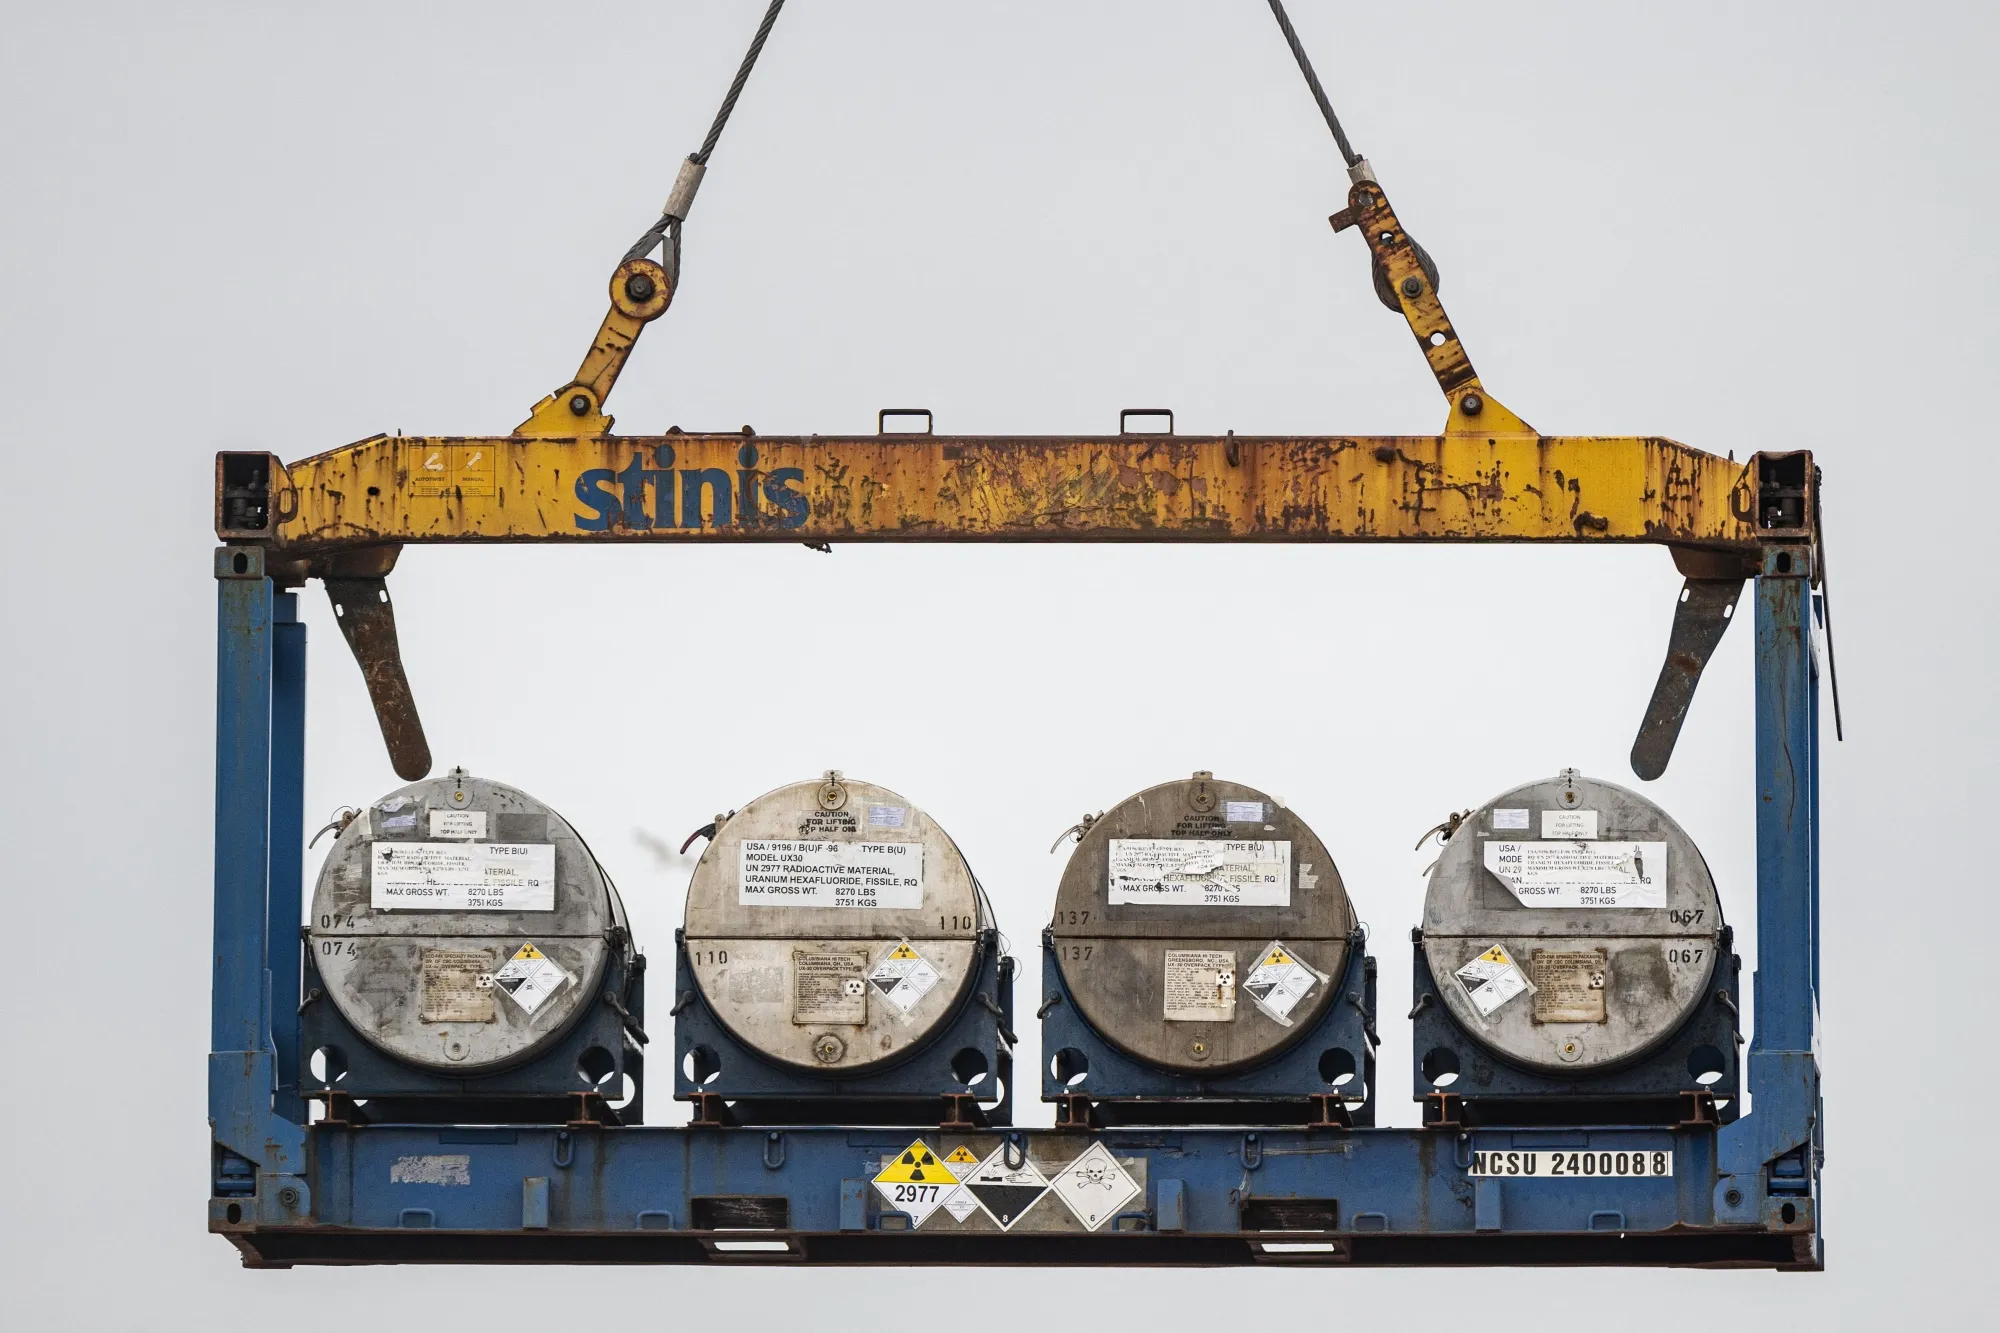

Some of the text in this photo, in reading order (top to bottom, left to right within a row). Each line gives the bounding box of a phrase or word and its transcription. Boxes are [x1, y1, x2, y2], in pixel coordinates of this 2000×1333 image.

[573, 444, 810, 531] stinis
[512, 847, 528, 855] B(U)
[799, 844, 823, 853] B(U)F
[887, 846, 906, 855] B(U)
[1248, 843, 1265, 852] B(U)
[485, 868, 519, 876] ATERIAL,
[783, 866, 845, 874] RADIOACTIVE
[847, 867, 895, 875] MATERIAL,
[790, 876, 863, 886] HEXAFLUORIDE,
[865, 877, 902, 887] FISSILE,
[767, 887, 800, 895] GROSS
[321, 914, 354, 928] 074
[940, 915, 971, 930] 110
[1059, 911, 1089, 925] 137
[1669, 910, 1704, 924] 067
[322, 942, 355, 956] 074
[1062, 946, 1093, 960] 137
[696, 950, 728, 965] 110
[1669, 949, 1703, 964] 067
[1472, 1153, 1536, 1175] NCSU
[895, 1185, 940, 1202] 2977
[1003, 1214, 1009, 1222] 8
